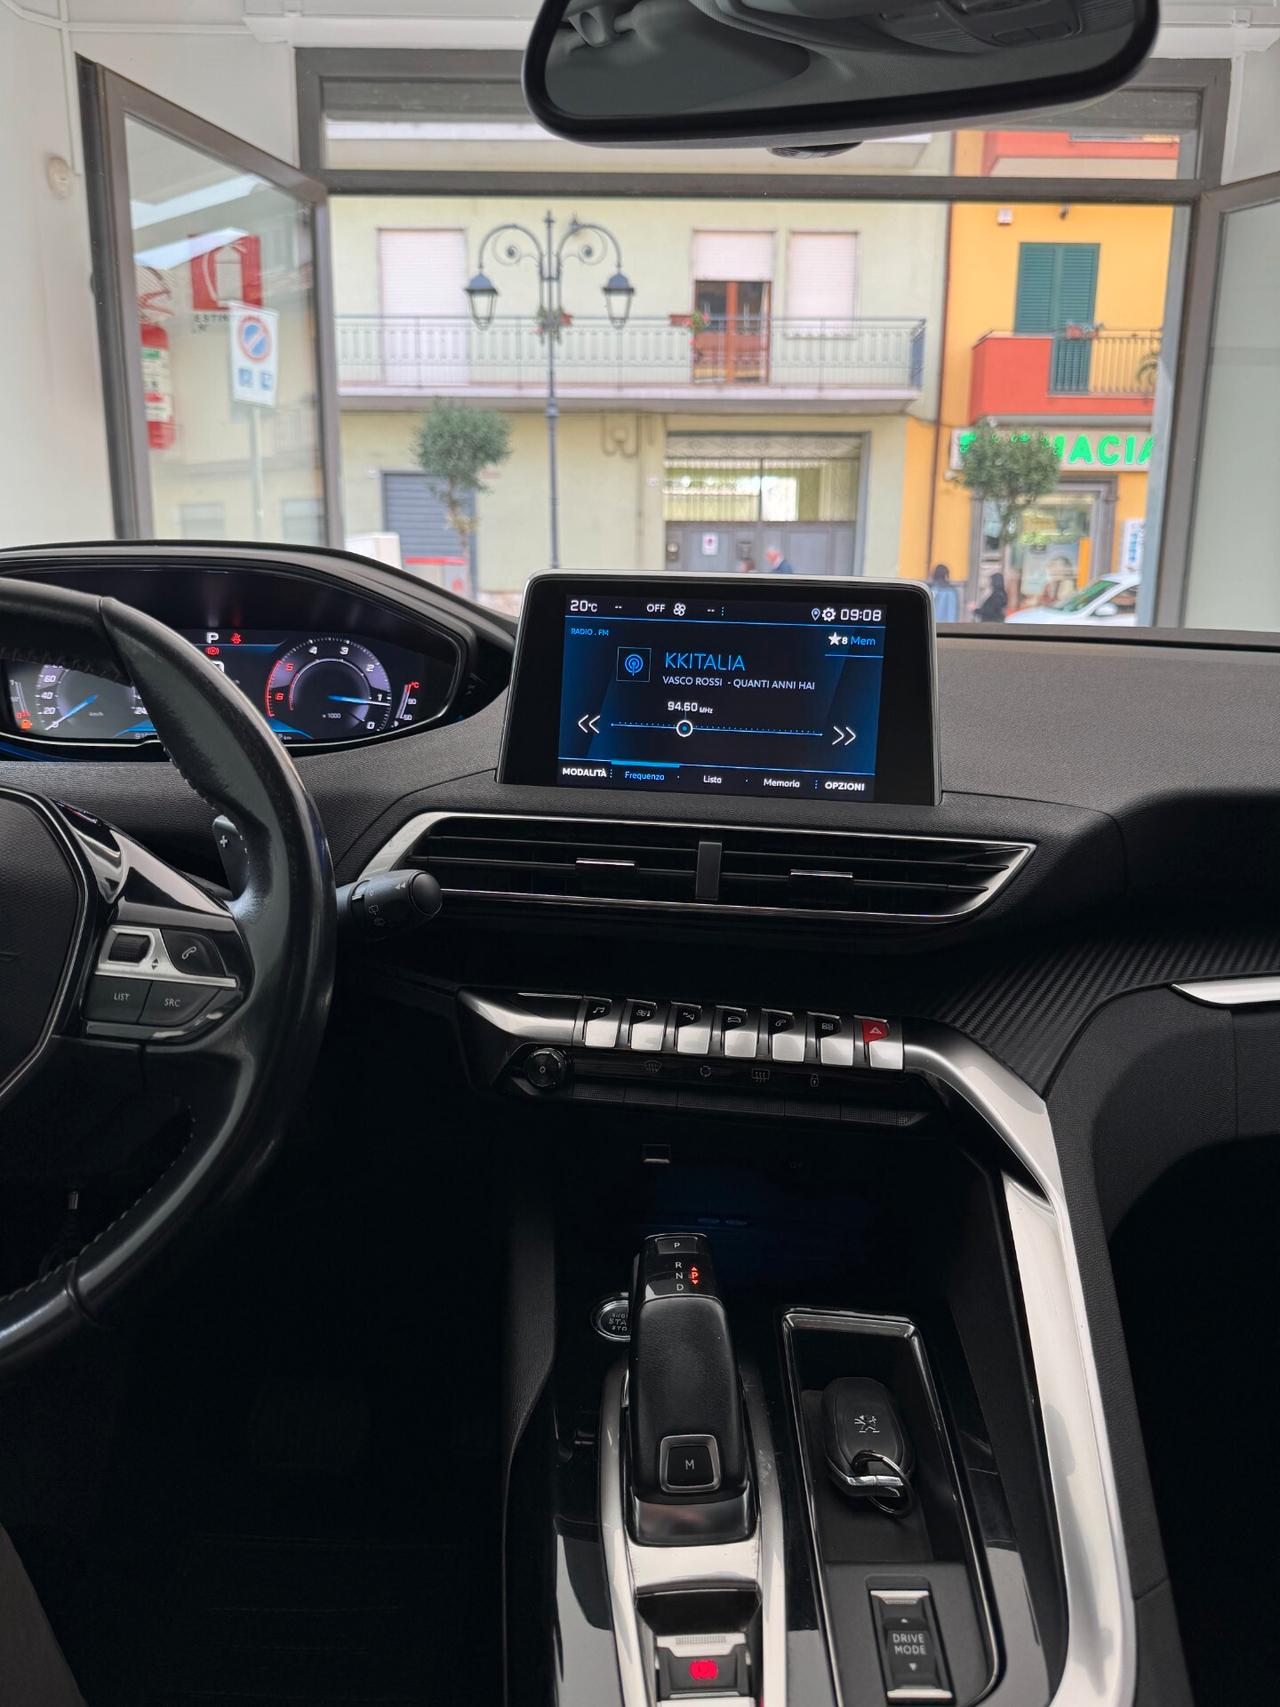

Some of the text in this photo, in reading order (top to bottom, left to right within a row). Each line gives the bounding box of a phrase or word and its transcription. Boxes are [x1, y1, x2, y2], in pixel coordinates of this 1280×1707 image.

[570, 600, 598, 612] 20°C
[646, 603, 666, 613] OFF
[840, 608, 882, 621] 09:08
[571, 628, 593, 636] RADIO
[206, 632, 219, 644] P
[841, 636, 876, 646] 8 Mem
[309, 646, 318, 655] 4
[340, 646, 349, 655] 3
[286, 663, 294, 671] 5
[665, 652, 746, 672] KKITALIA
[366, 663, 375, 672] 2
[663, 676, 693, 686] VASCO
[695, 677, 723, 687] ROSSI
[733, 678, 770, 689] QUANTI
[771, 680, 796, 690] ANNI
[799, 681, 816, 690] HAI
[275, 692, 284, 701] 6
[377, 693, 383, 702] 1
[667, 701, 698, 712] 94.60
[366, 721, 376, 730] 0
[562, 766, 607, 778] MODALITÀ
[763, 778, 800, 788] Memoria
[824, 781, 865, 792] OPZIONI
[113, 992, 131, 1002] LIST
[164, 997, 181, 1008] SRC
[675, 1261, 682, 1269] R
[675, 1272, 684, 1280] N
[691, 1271, 699, 1280] P
[676, 1283, 685, 1291] D
[685, 1458, 695, 1470] M
[892, 1633, 925, 1644] DRIVE
[894, 1644, 927, 1655] MODE
